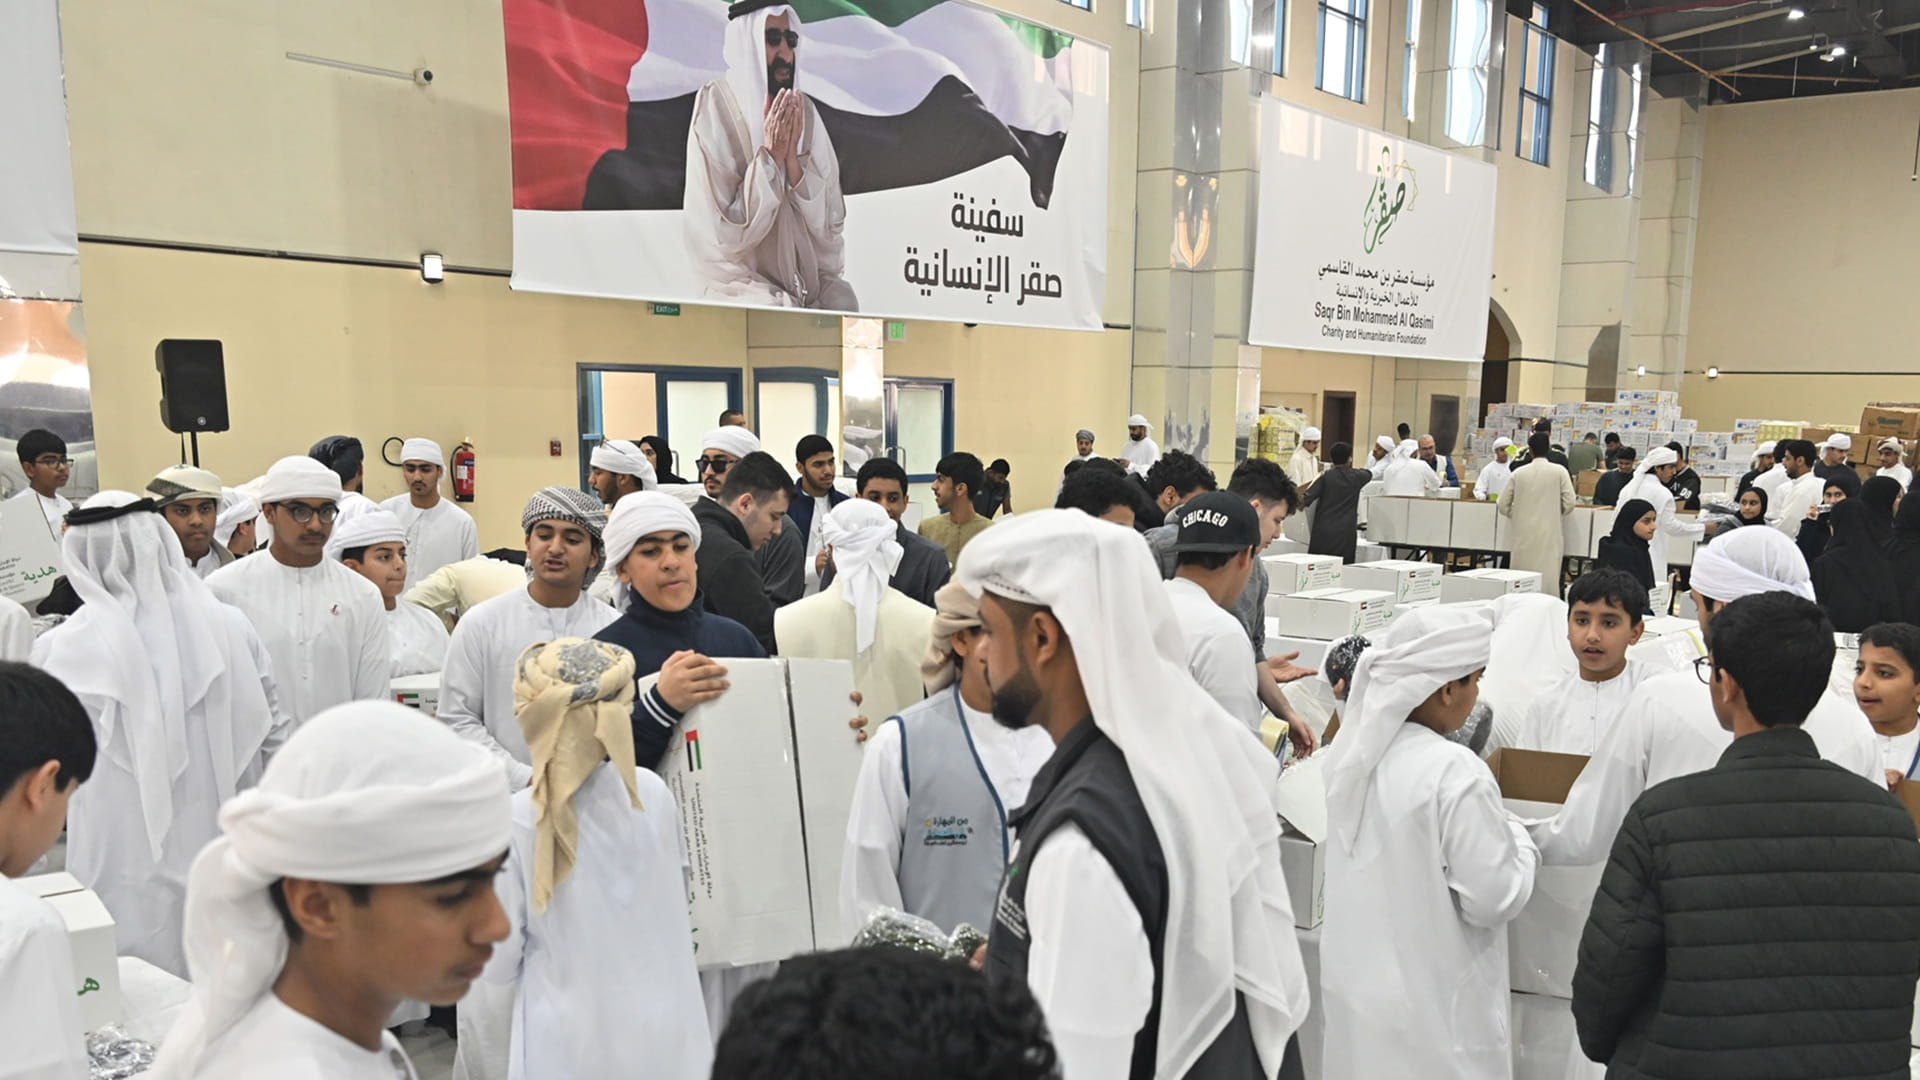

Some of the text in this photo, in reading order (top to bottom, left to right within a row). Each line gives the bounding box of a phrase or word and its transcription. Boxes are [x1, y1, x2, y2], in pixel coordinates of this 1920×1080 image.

[951, 192, 1024, 243] سفينة
[904, 246, 1062, 306] صقر الإنسانية
[1318, 258, 1434, 292] مؤسسة صقر بن محمد القاسمي
[1314, 301, 1434, 329] Saqr Bin Mohammed Al Qasimi
[1321, 324, 1427, 345] Charity and Humanitarian Foundation
[1182, 509, 1229, 529] CHICAGO
[20, 565, 57, 584] هدية
